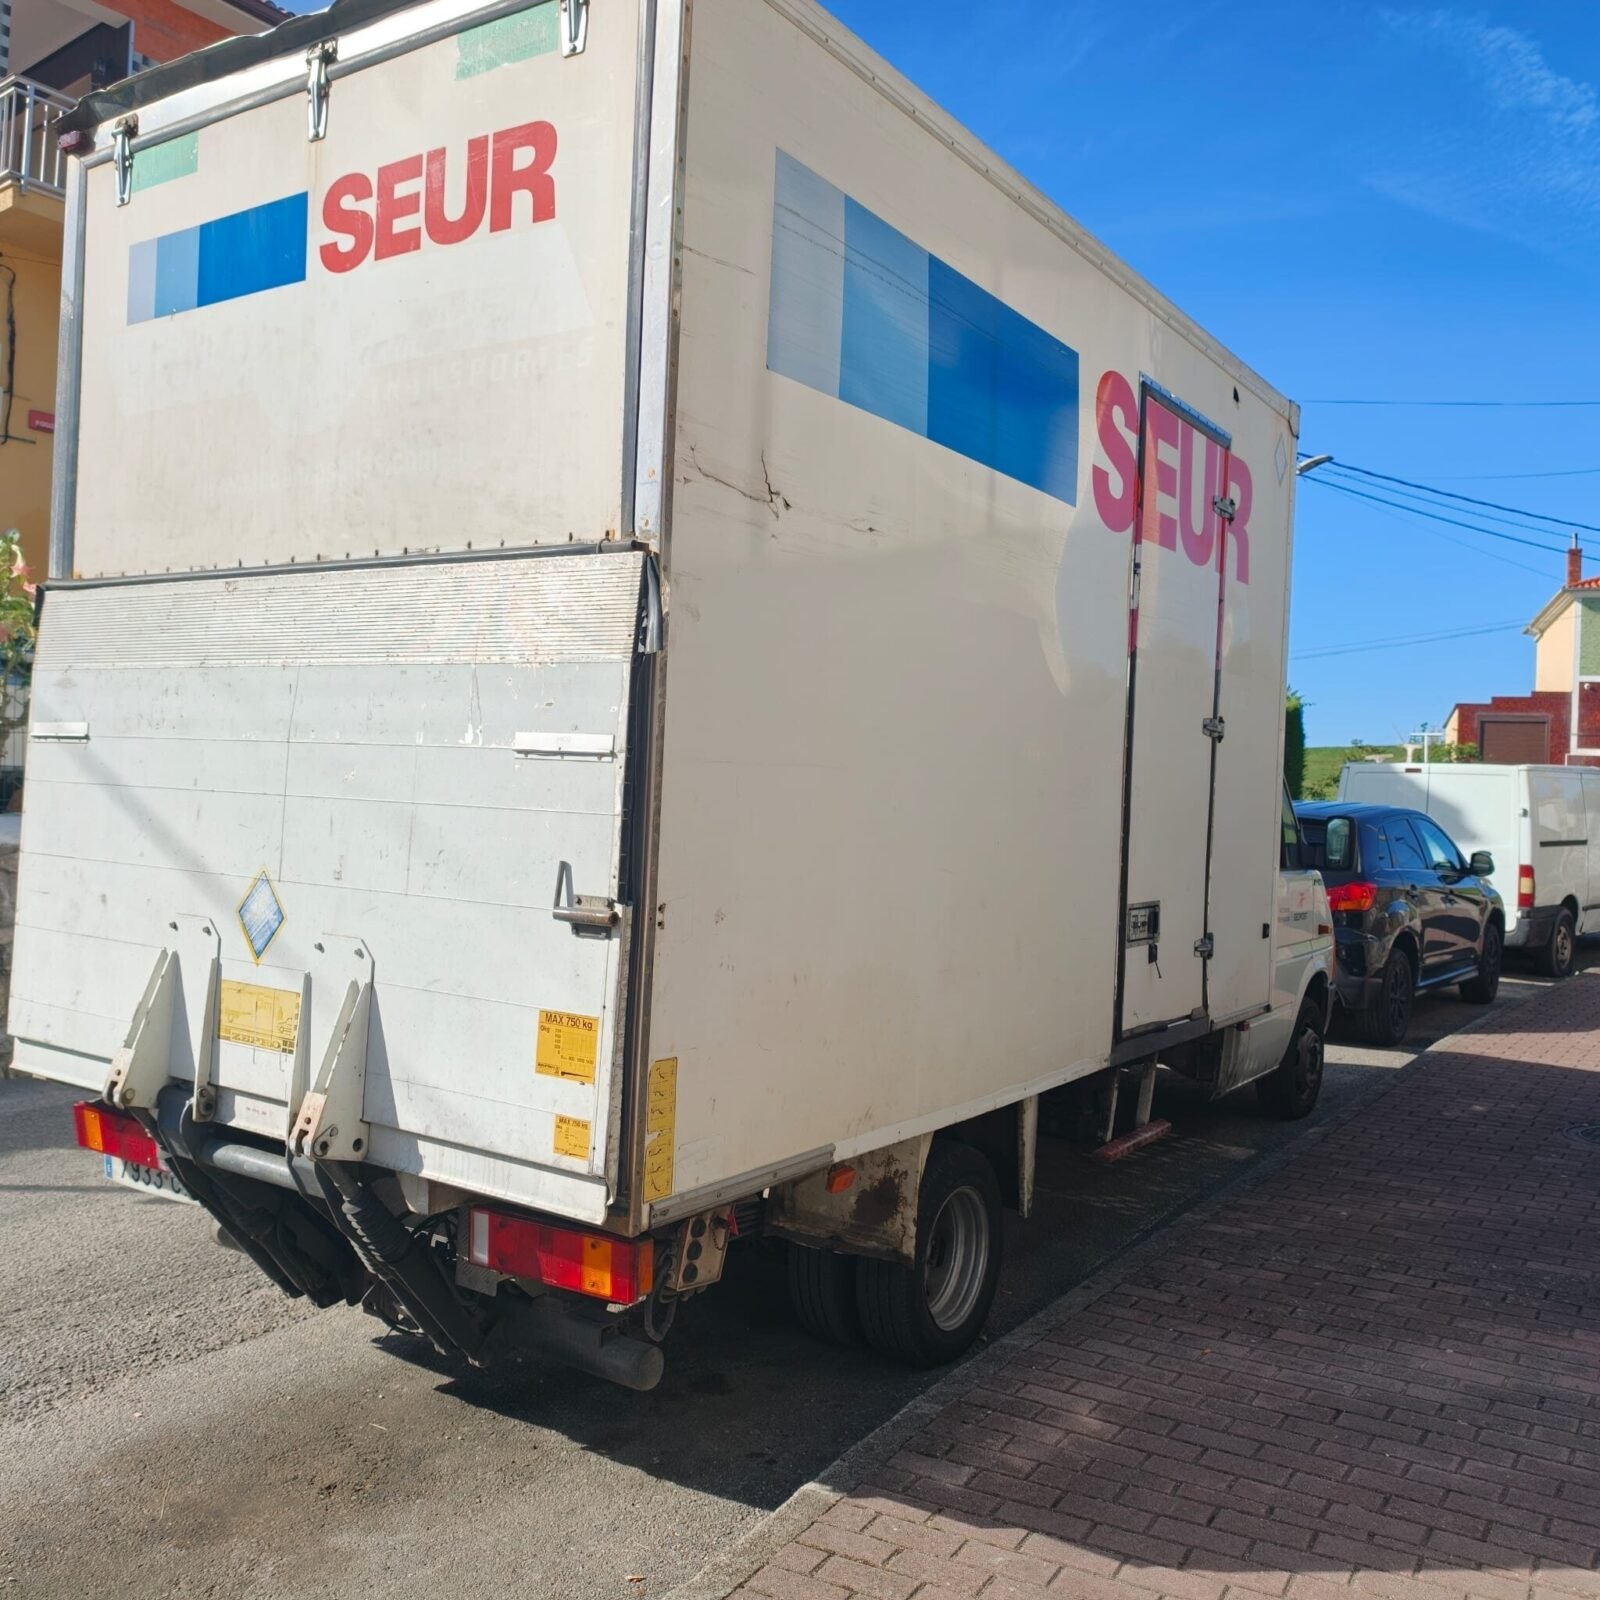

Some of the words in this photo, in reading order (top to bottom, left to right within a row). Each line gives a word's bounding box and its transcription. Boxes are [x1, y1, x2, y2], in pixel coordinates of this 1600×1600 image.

[319, 120, 558, 273] SEUR
[1092, 370, 1253, 584] SEUR
[544, 1013, 564, 1025] MAX
[566, 1017, 580, 1027] 750
[582, 1020, 593, 1031] kg
